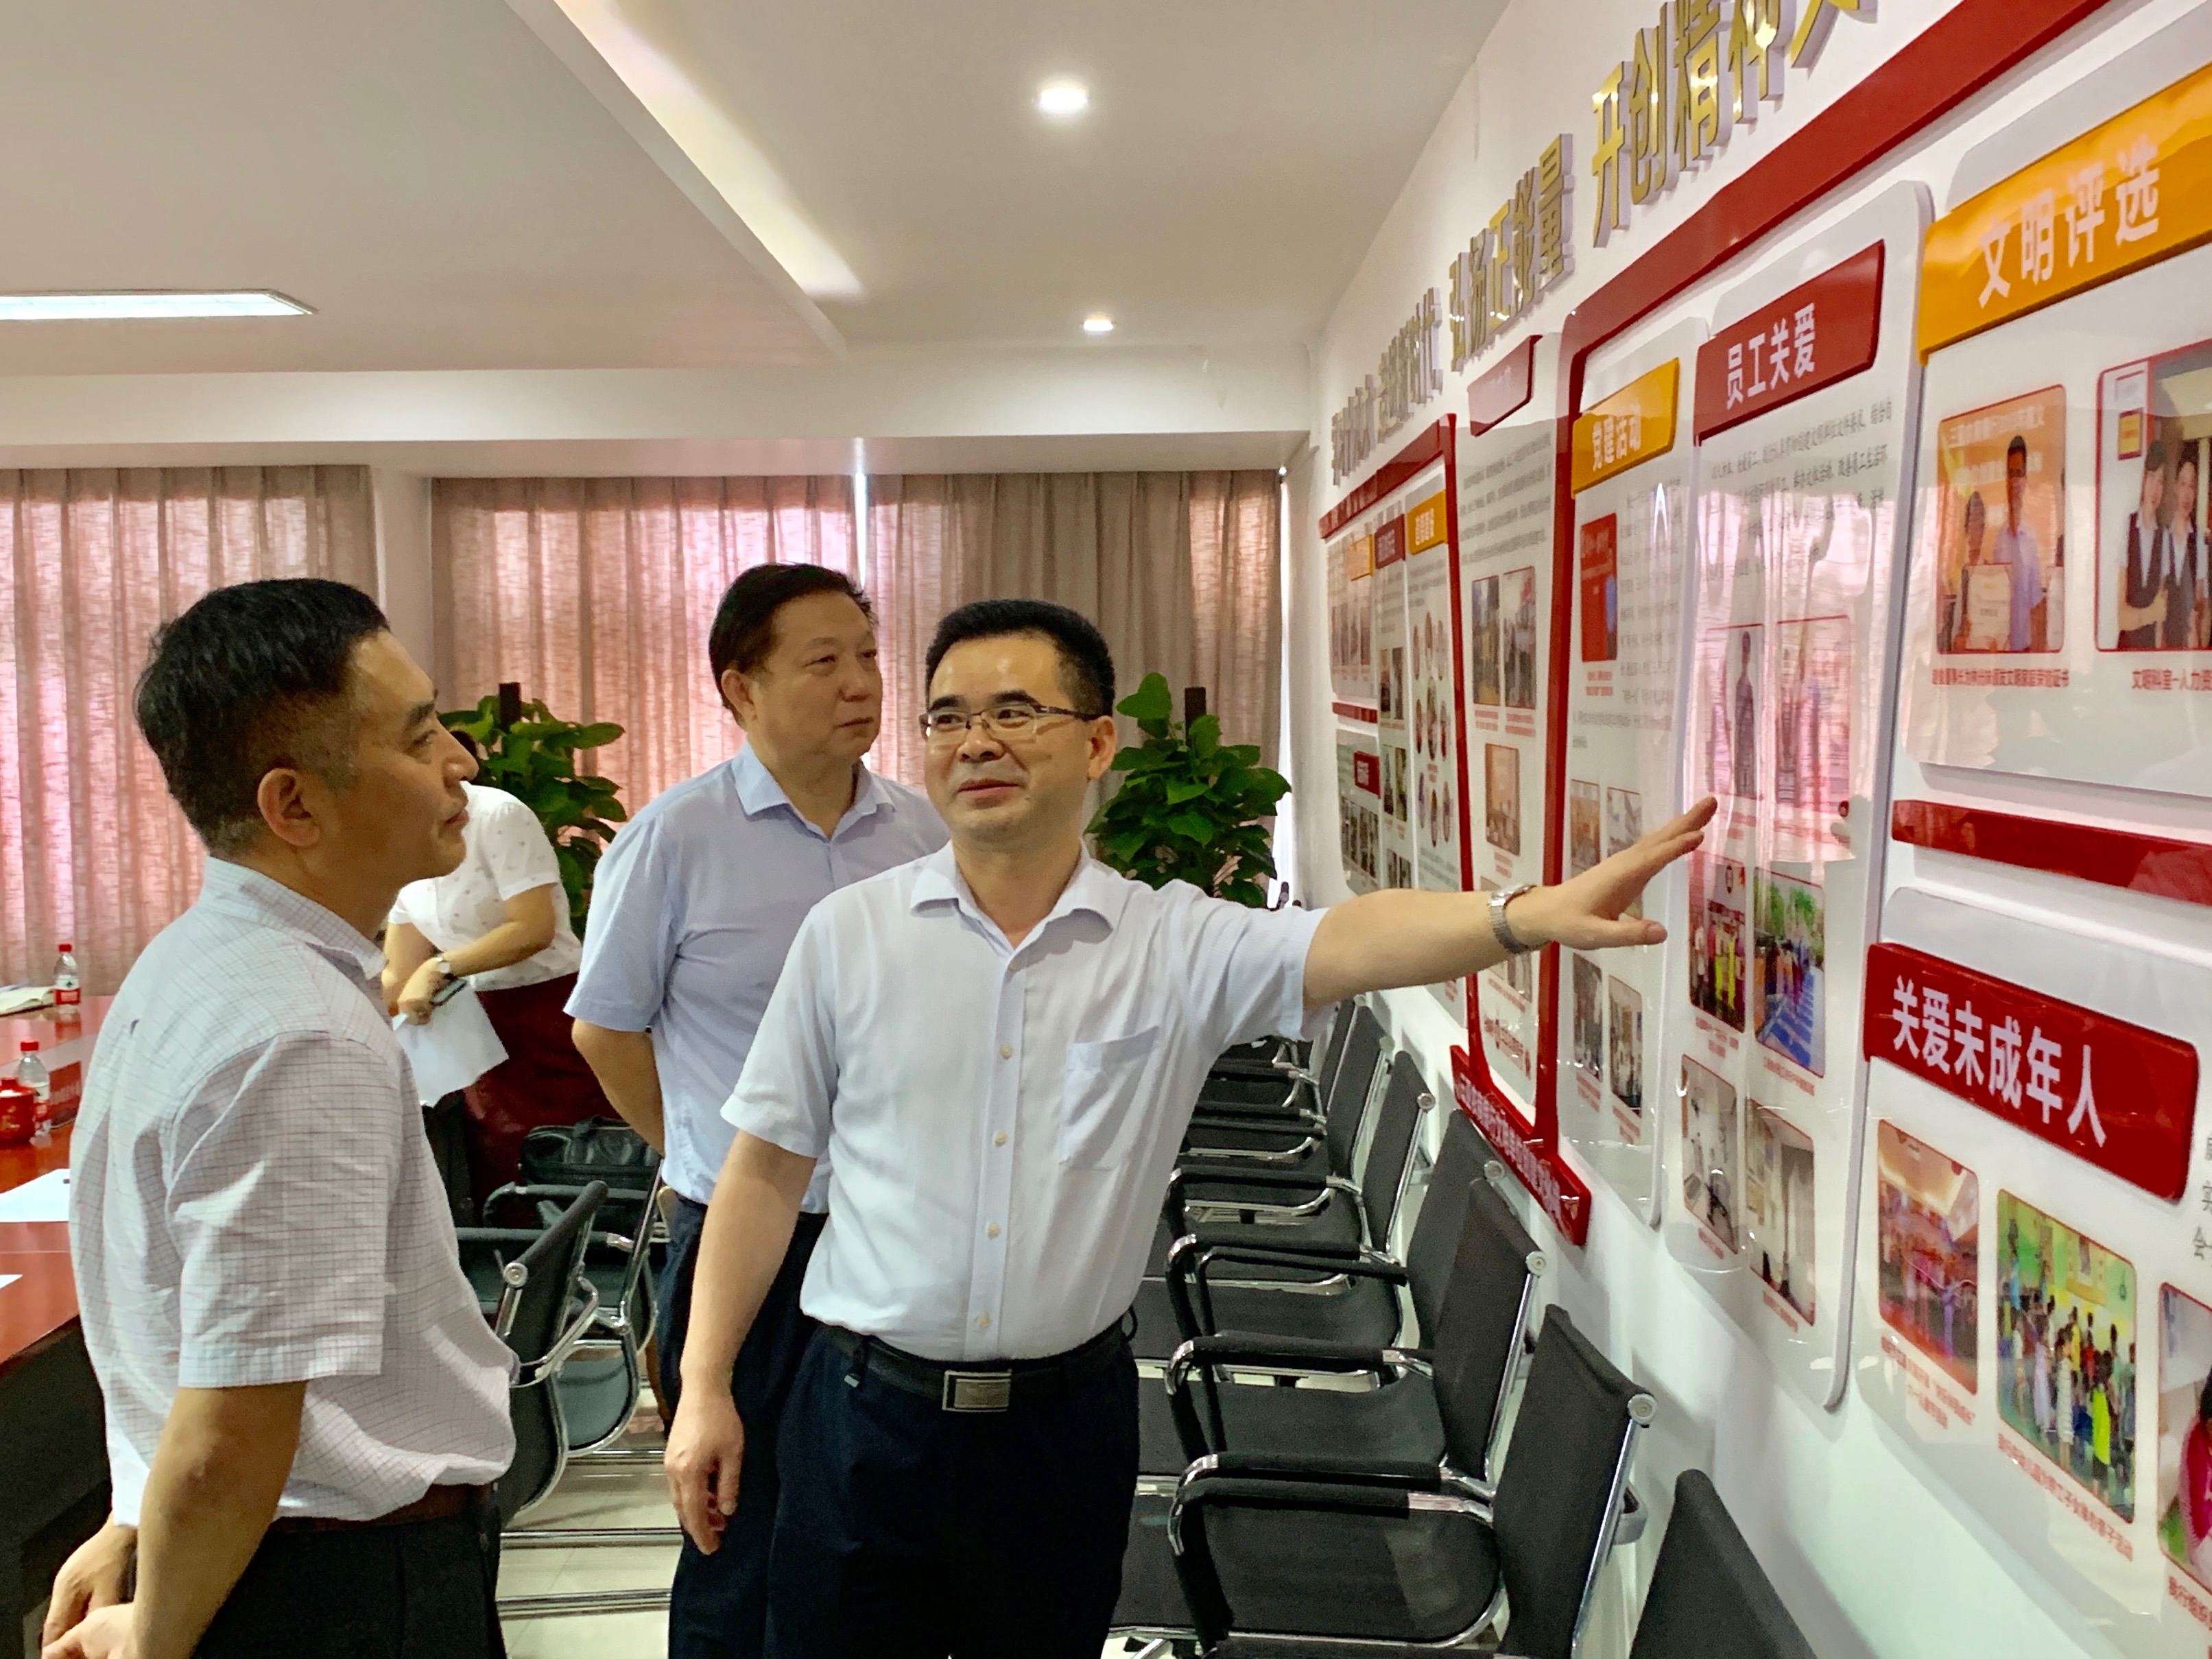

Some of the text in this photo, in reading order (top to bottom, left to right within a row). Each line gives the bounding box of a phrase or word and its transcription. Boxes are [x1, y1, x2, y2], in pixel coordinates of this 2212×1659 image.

[1591, 0, 1860, 248] 开创精神
[1978, 134, 2160, 308] 文明评选
[1726, 302, 1816, 409] 员工关爱
[1892, 977, 2106, 1147] 关爱未成年人
